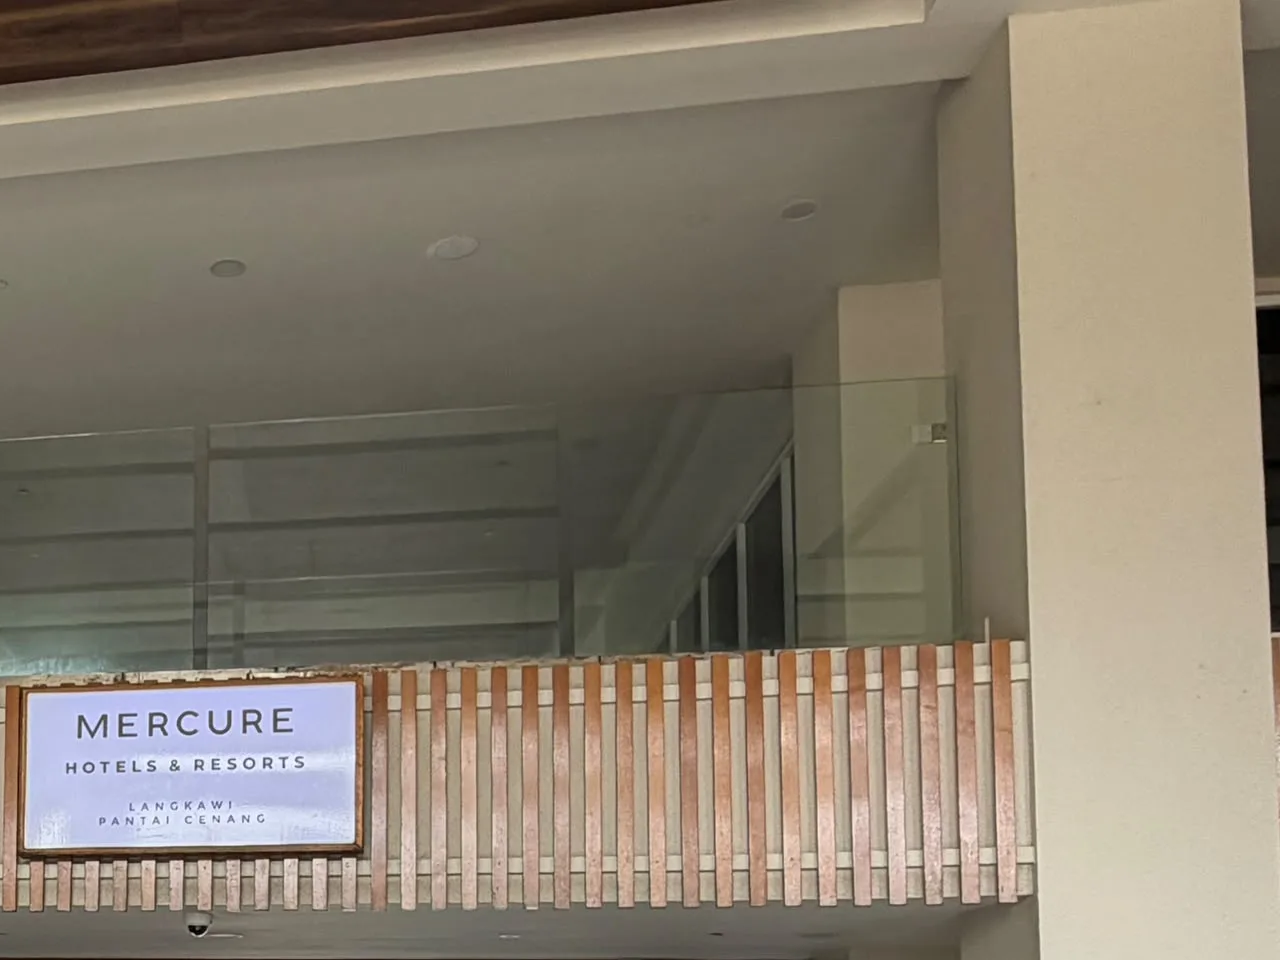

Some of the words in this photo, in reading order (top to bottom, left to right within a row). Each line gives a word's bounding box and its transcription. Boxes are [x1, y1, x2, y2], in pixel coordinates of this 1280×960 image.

[77, 708, 294, 739] MERCURE
[65, 760, 157, 775] HOTELS
[169, 759, 181, 772] &
[194, 756, 306, 772] RESORTS
[129, 801, 233, 812] LANGKAWI
[99, 816, 170, 826] PANTAI
[185, 813, 266, 825] CENANG
